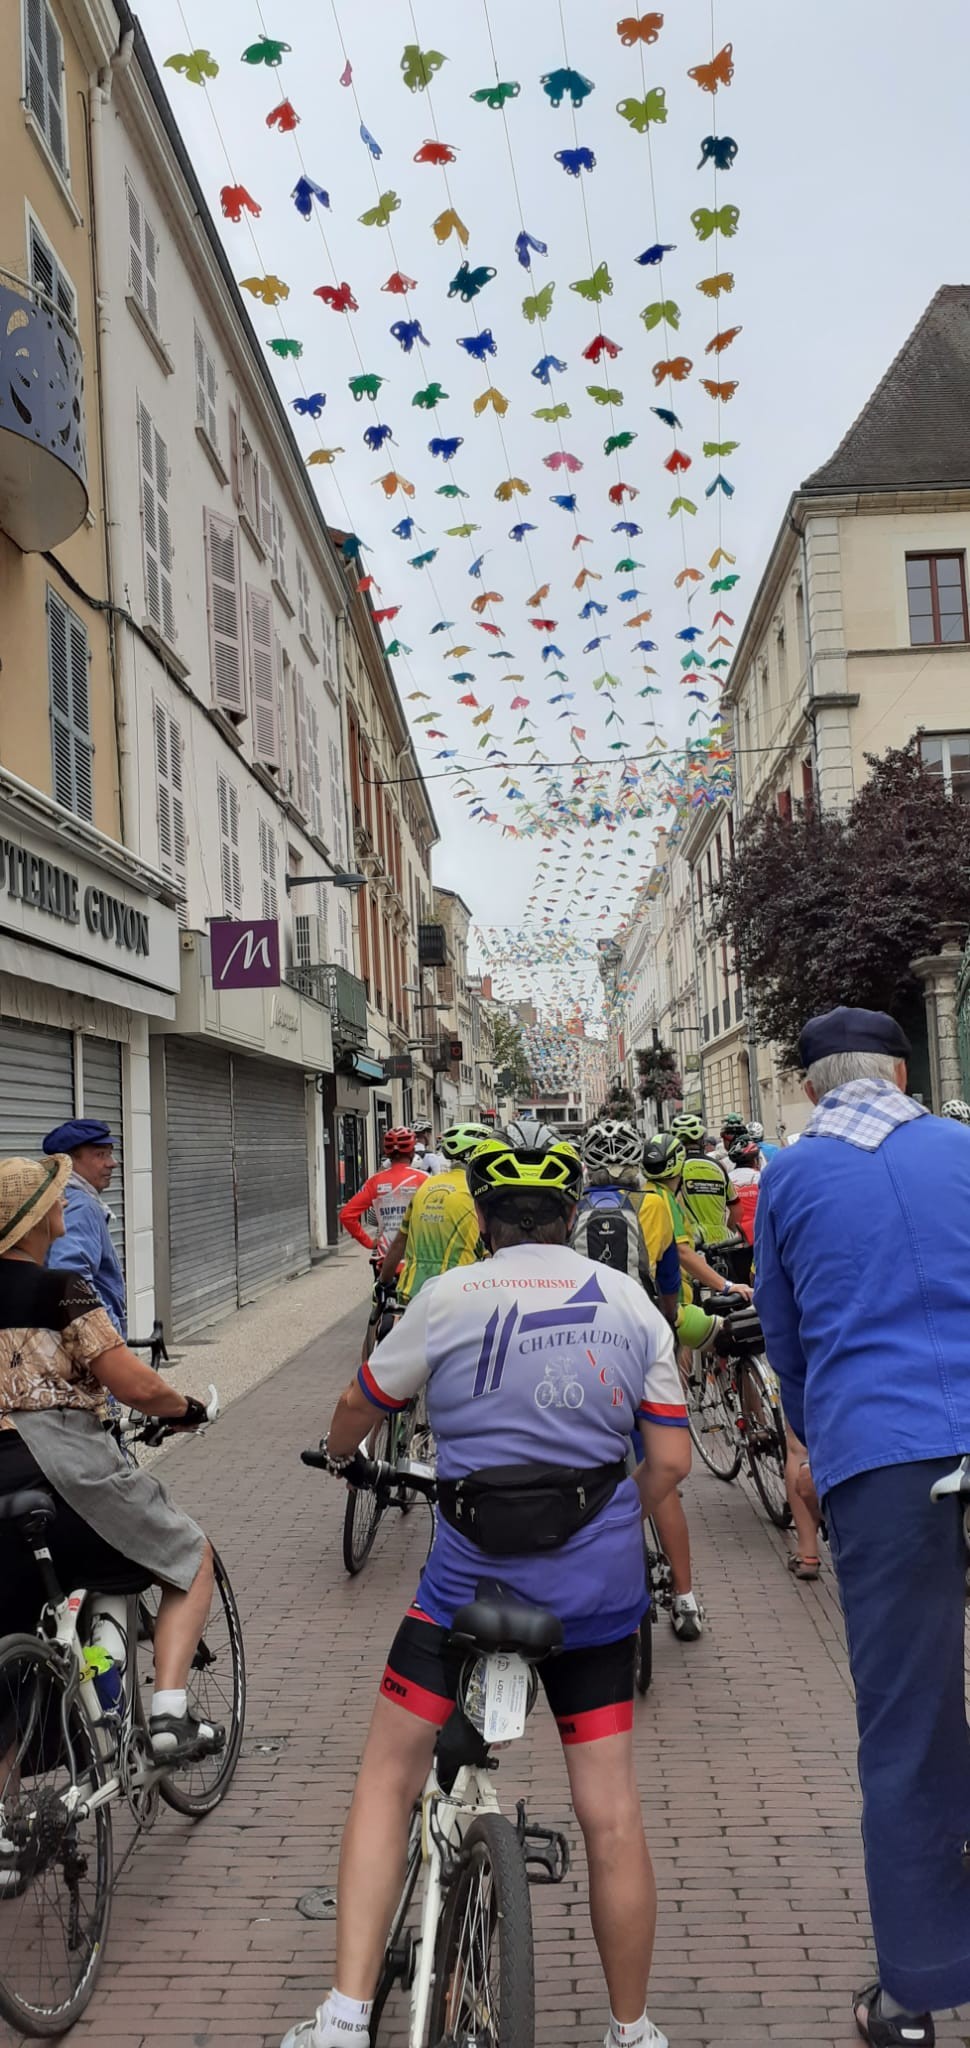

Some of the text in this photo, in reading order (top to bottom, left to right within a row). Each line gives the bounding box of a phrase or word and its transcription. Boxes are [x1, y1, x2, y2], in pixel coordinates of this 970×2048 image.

[84, 885, 150, 956] GUYON
[220, 929, 271, 980] M
[380, 1206, 406, 1217] SUPER
[463, 1279, 577, 1292] CYCLOTOURISME
[518, 1330, 632, 1356] CHATEAUDUN
